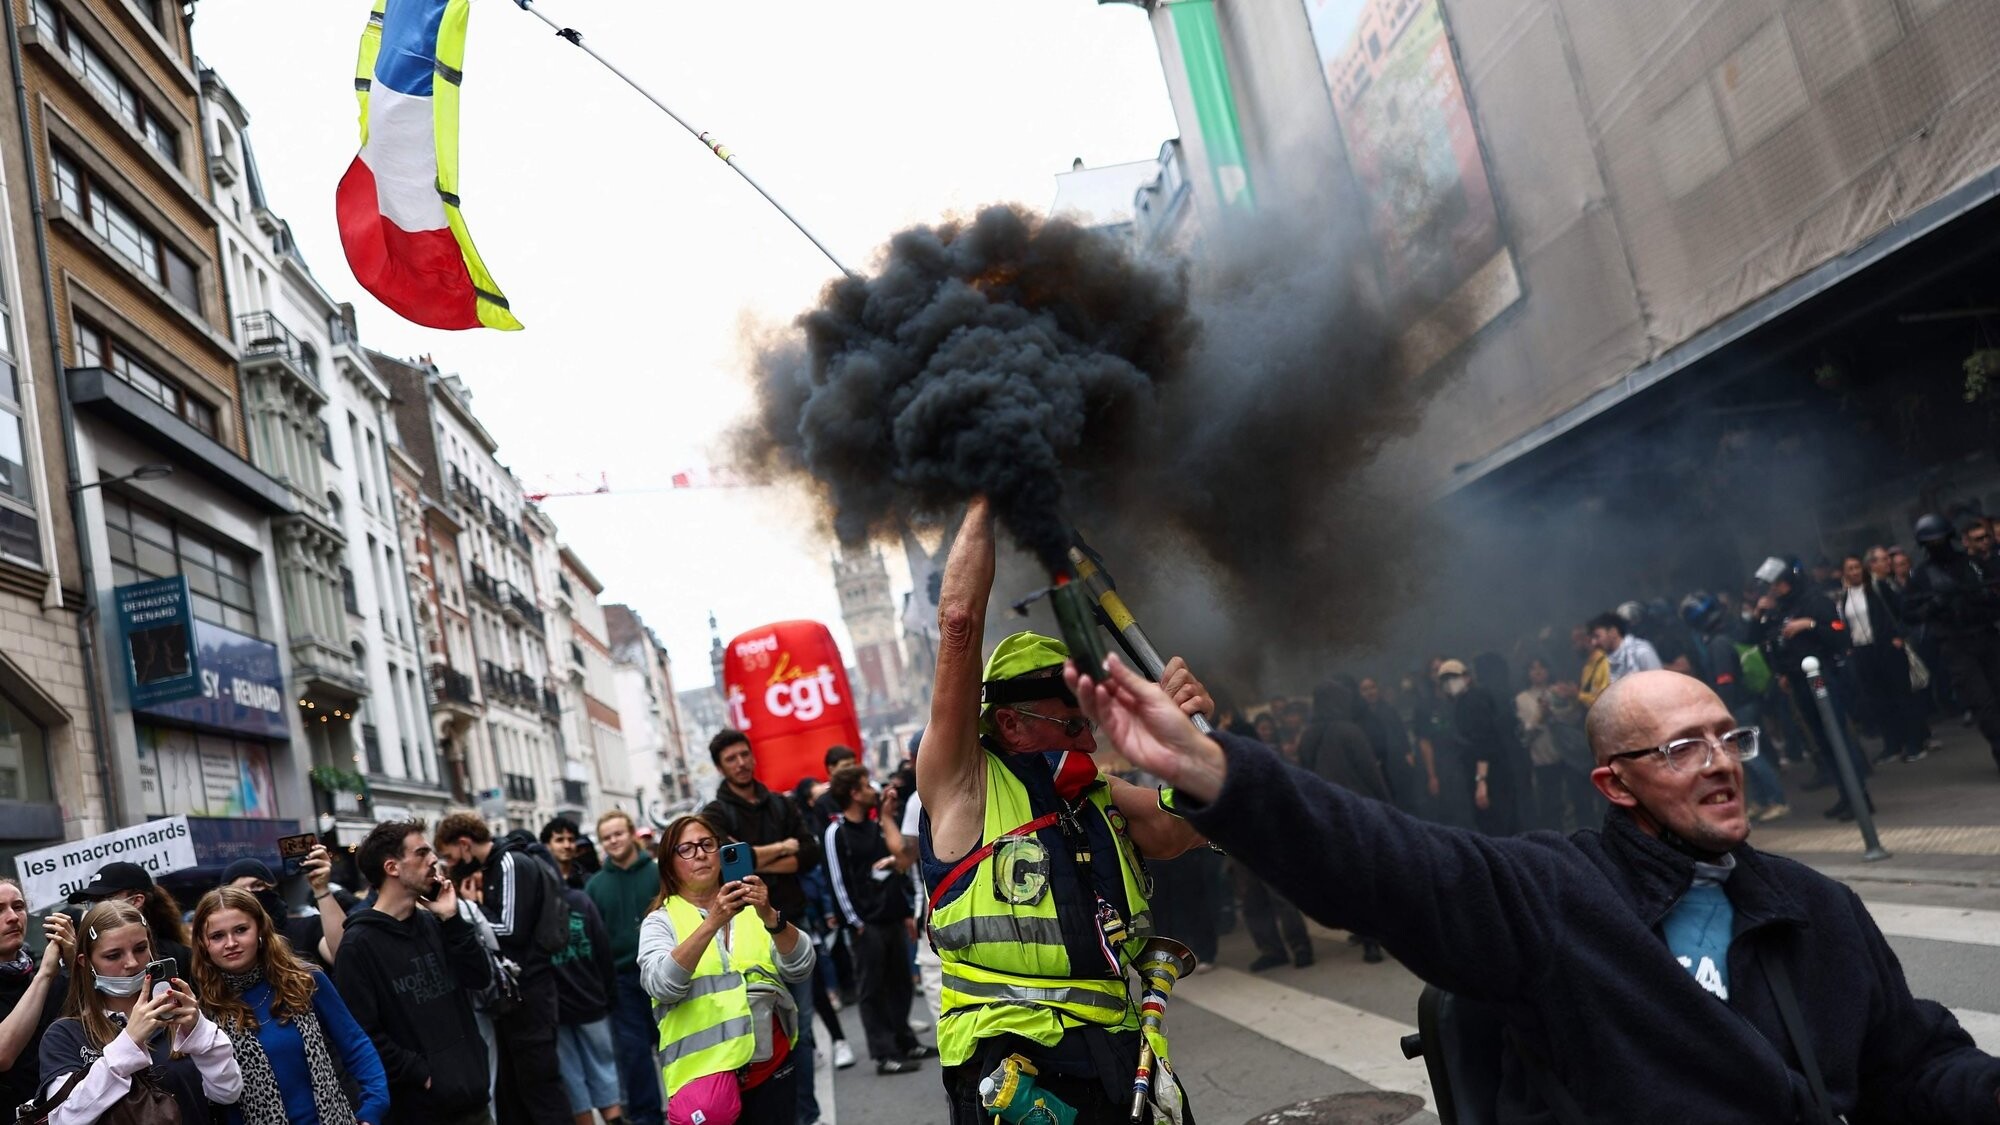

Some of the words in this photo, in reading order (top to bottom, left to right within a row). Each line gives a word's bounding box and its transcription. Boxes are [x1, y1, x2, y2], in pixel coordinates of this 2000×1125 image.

[131, 606, 177, 624] RENARD
[735, 633, 779, 657] nord
[232, 677, 281, 713] RENARD
[764, 664, 842, 722] cgt
[23, 858, 57, 878] les
[62, 822, 187, 868] macronnards
[58, 878, 86, 897] au
[996, 841, 1046, 904] G
